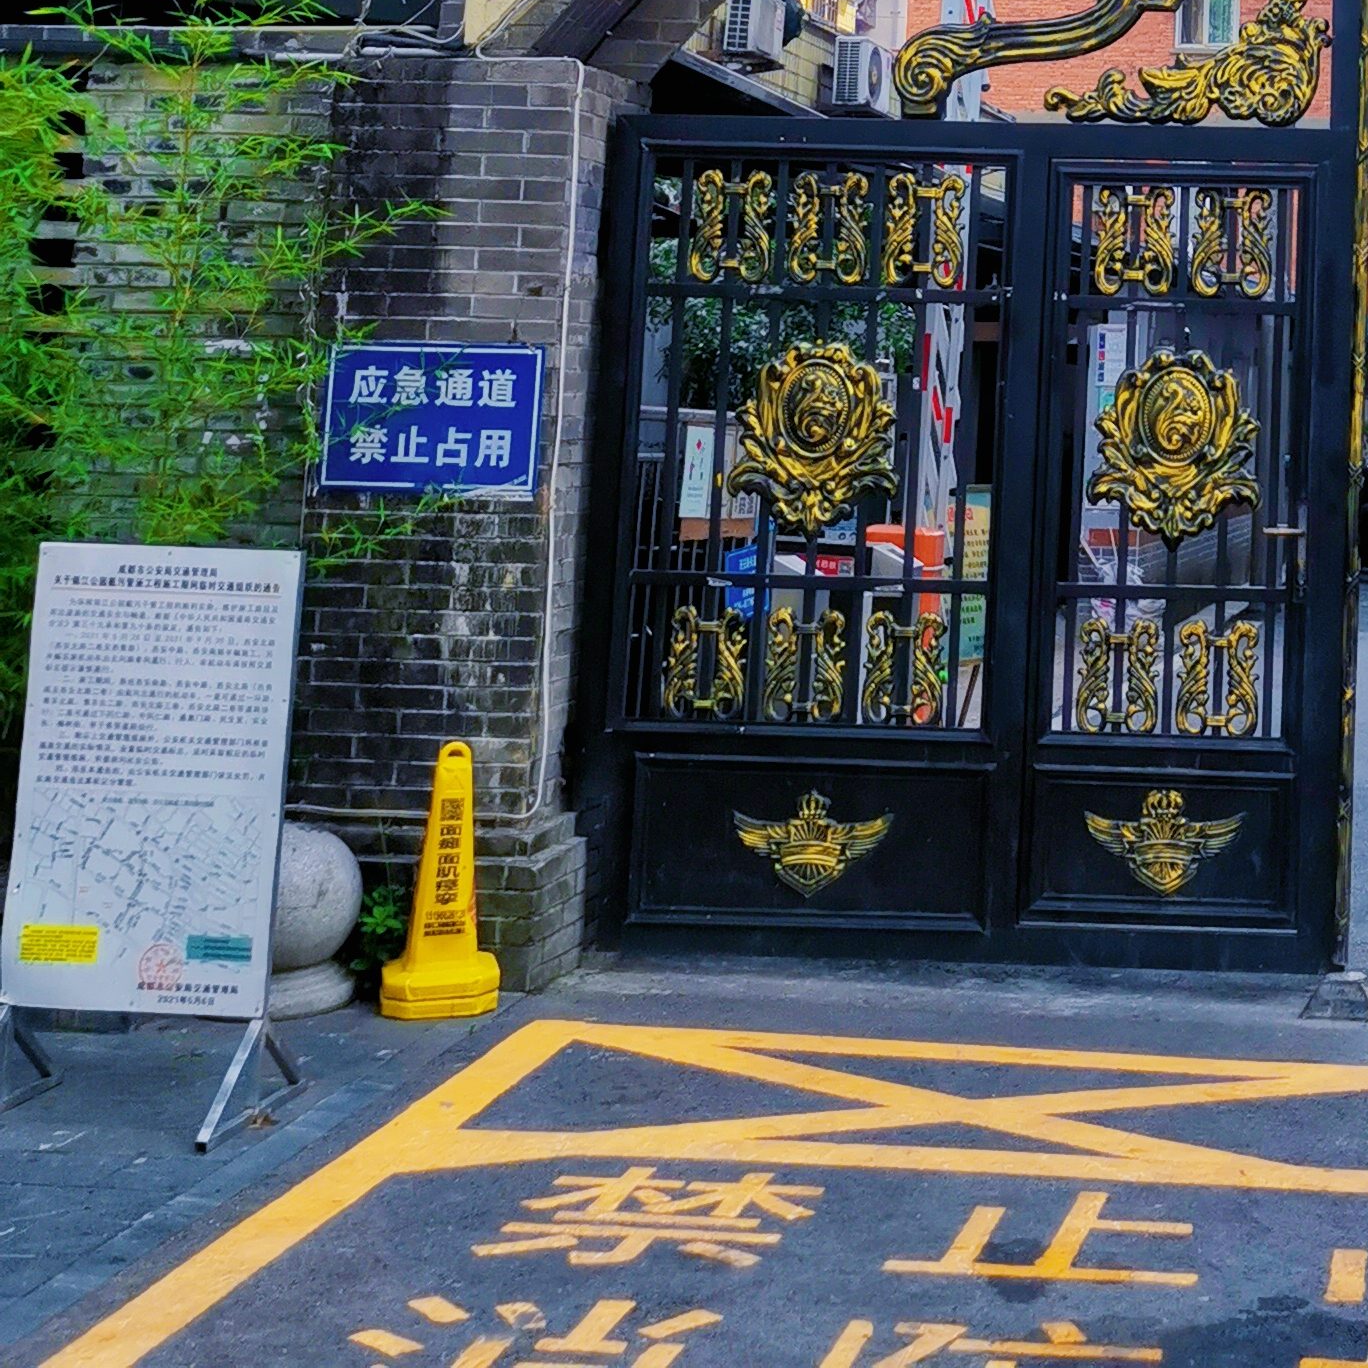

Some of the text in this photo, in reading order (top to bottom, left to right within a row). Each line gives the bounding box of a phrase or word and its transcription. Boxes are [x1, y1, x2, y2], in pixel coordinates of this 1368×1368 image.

[348, 365, 518, 409] 应急通道
[348, 424, 513, 469] 禁止占用
